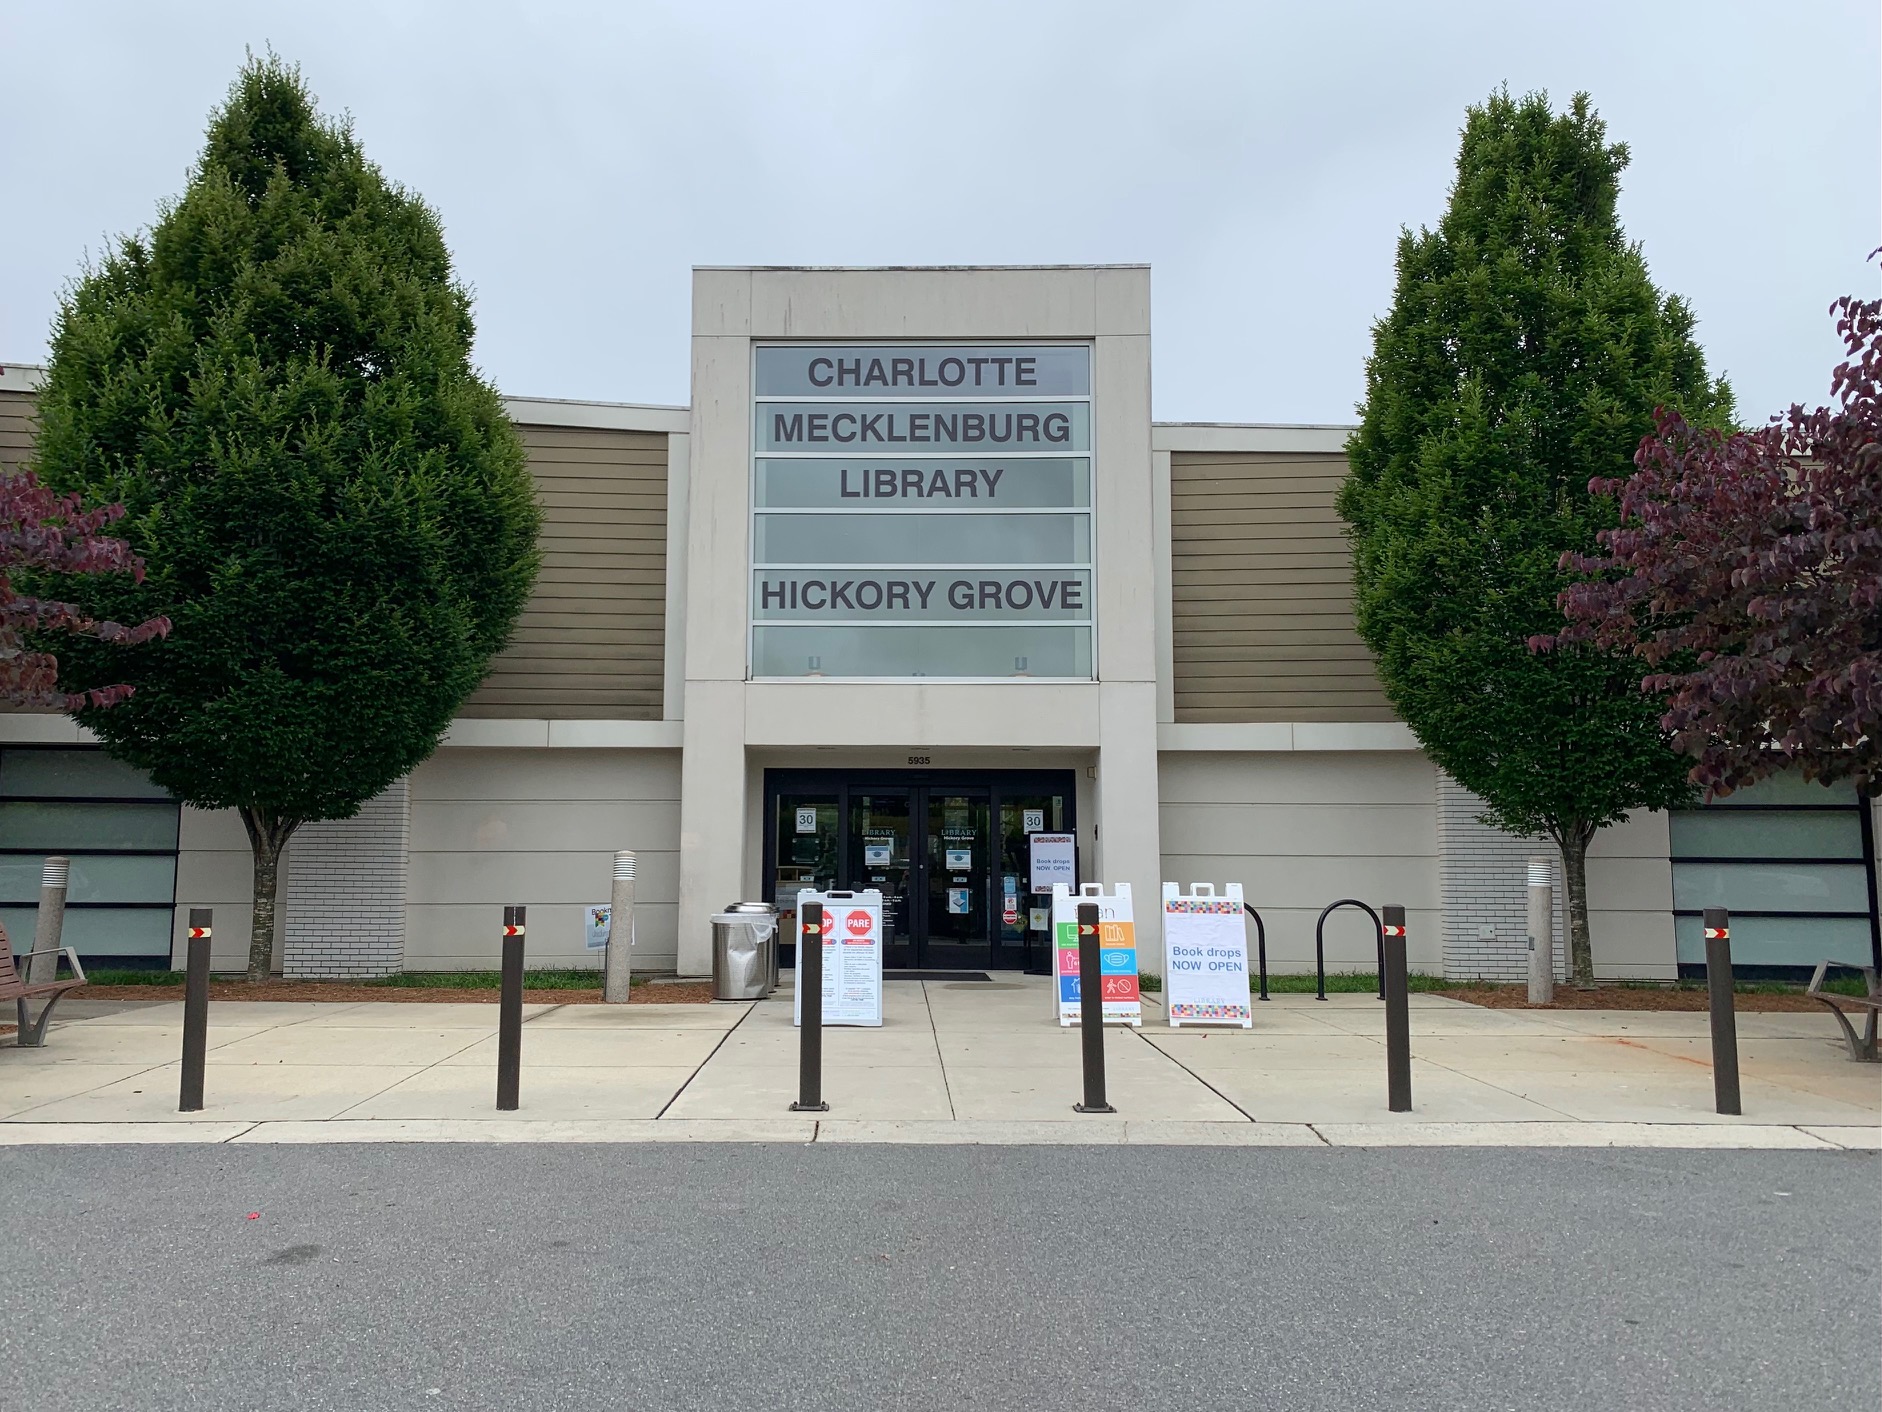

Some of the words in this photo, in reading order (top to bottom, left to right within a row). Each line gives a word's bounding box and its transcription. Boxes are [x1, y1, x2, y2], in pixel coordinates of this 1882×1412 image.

[808, 358, 1037, 387] CHARLOTTE
[774, 413, 1070, 443] MECKLENBURG
[840, 469, 1004, 498] LIBRARY
[762, 580, 936, 610] HICKORY
[948, 580, 1083, 610] GROVE
[908, 756, 930, 765] 5935
[799, 815, 813, 824] 30
[1026, 816, 1041, 826] 30
[847, 918, 870, 928] PARE
[1172, 946, 1203, 956] Book
[1206, 947, 1241, 959] drops
[1172, 960, 1202, 971] NOW
[1208, 961, 1242, 972] OPEN
